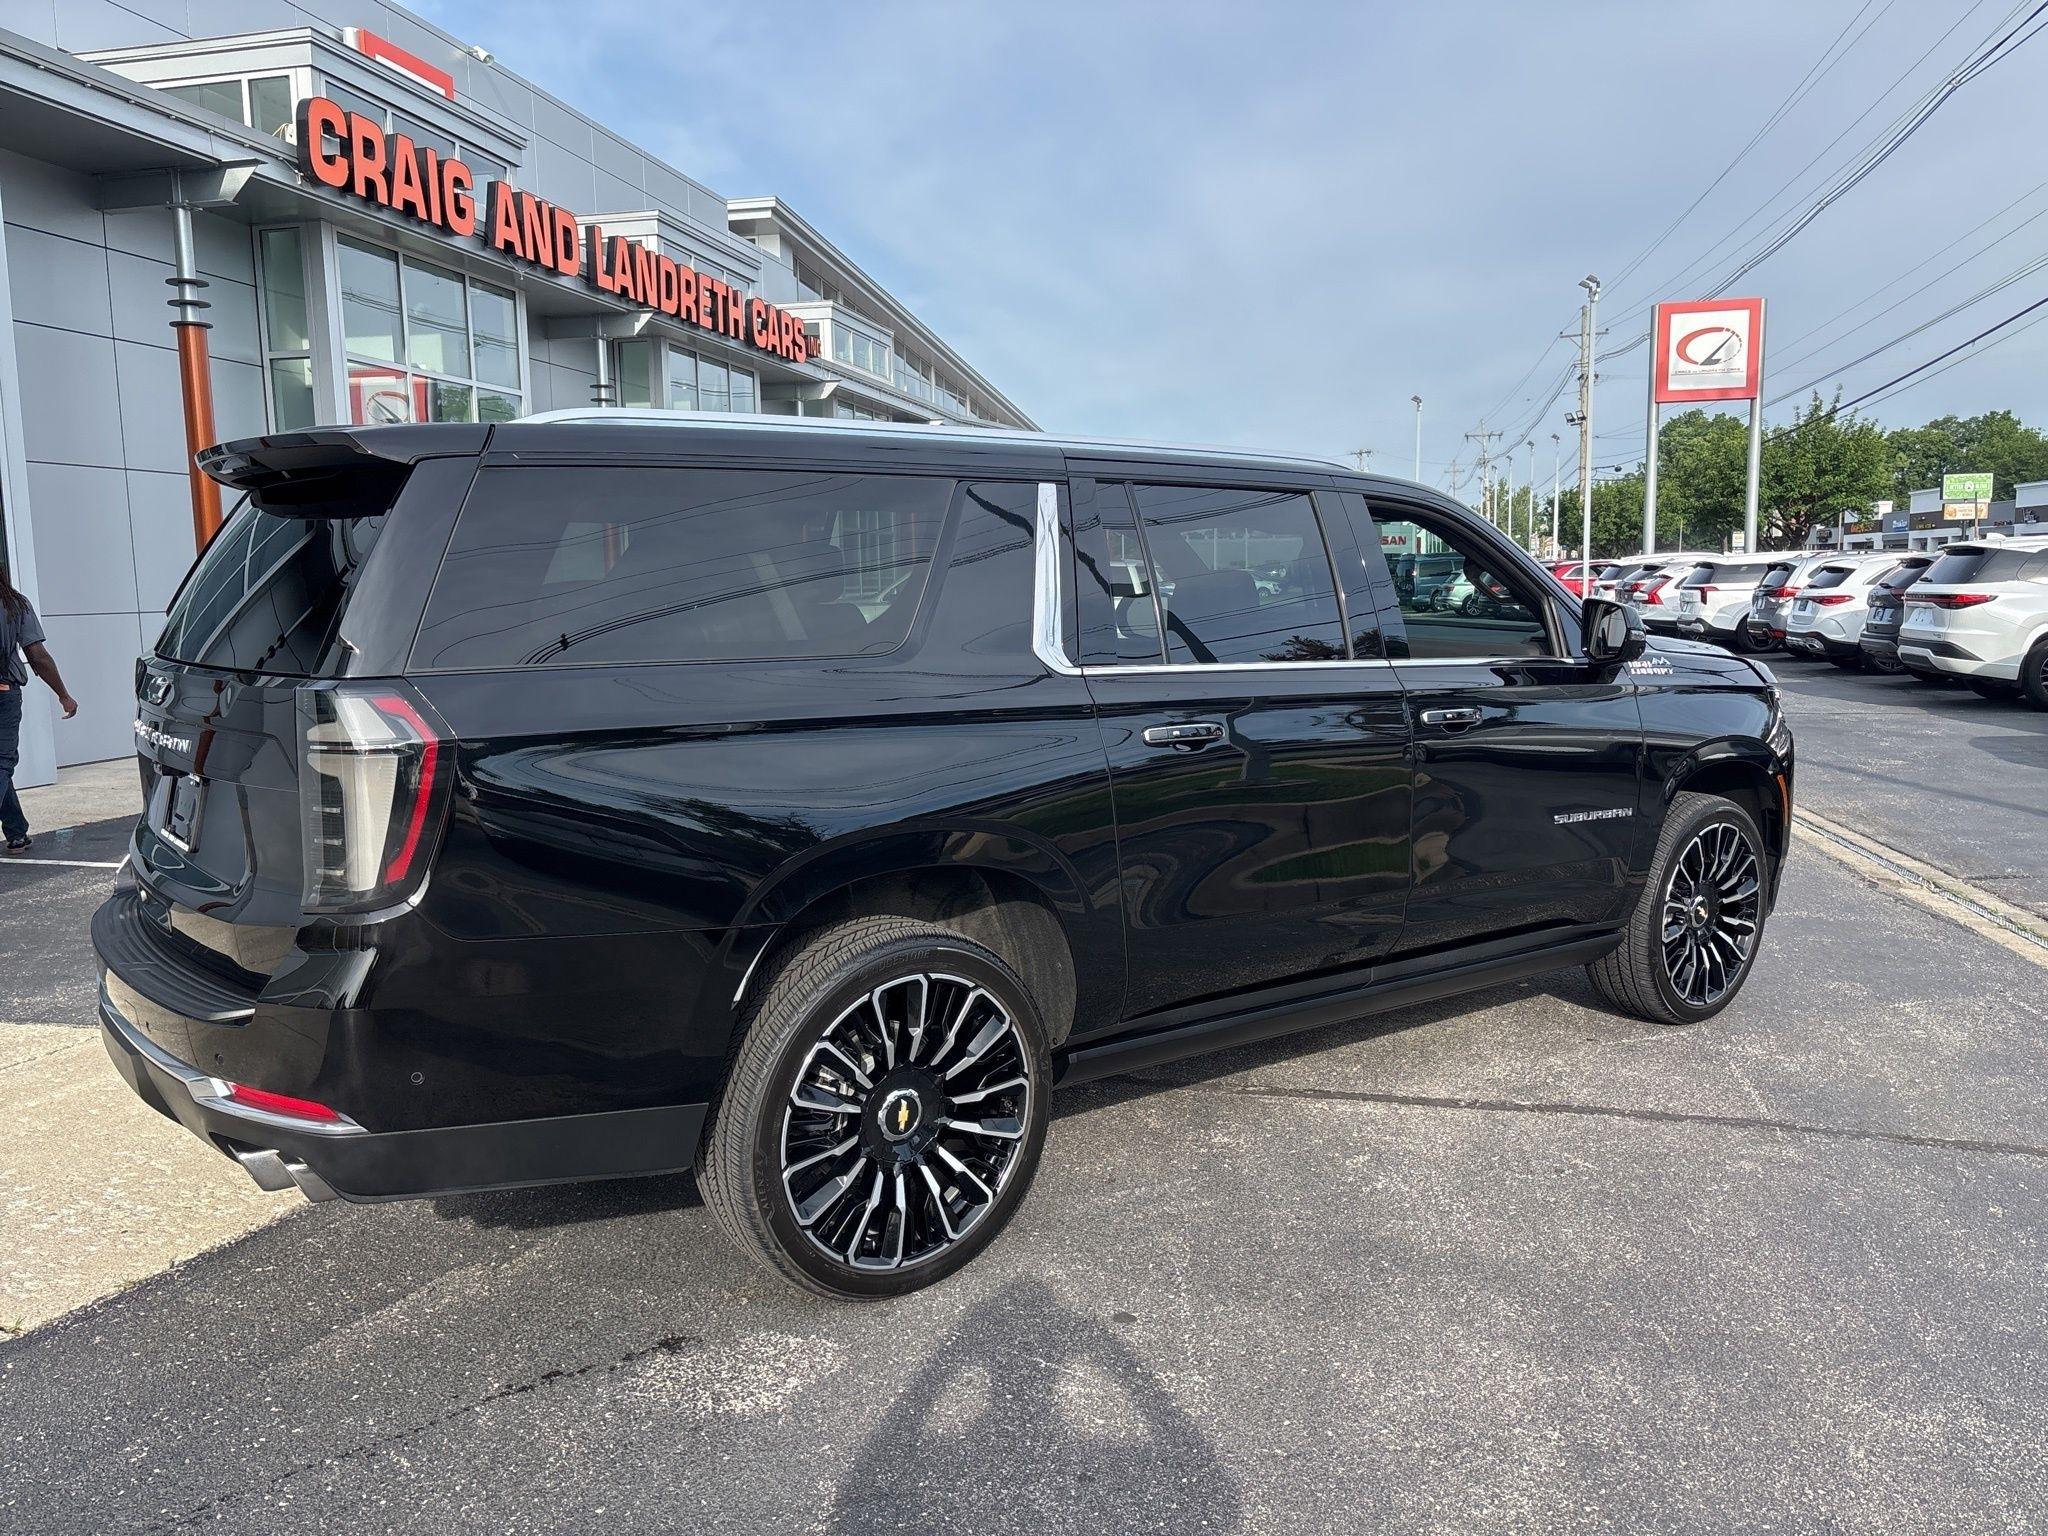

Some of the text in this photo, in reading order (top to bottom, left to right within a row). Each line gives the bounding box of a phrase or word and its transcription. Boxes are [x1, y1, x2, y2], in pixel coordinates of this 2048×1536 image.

[303, 96, 476, 237] CRAIG
[491, 181, 581, 277] AND
[590, 225, 745, 341] LANDRETH
[749, 297, 806, 364] CARS
[1379, 535, 1407, 546] SAN
[1553, 807, 1633, 825] SUBURBAN
